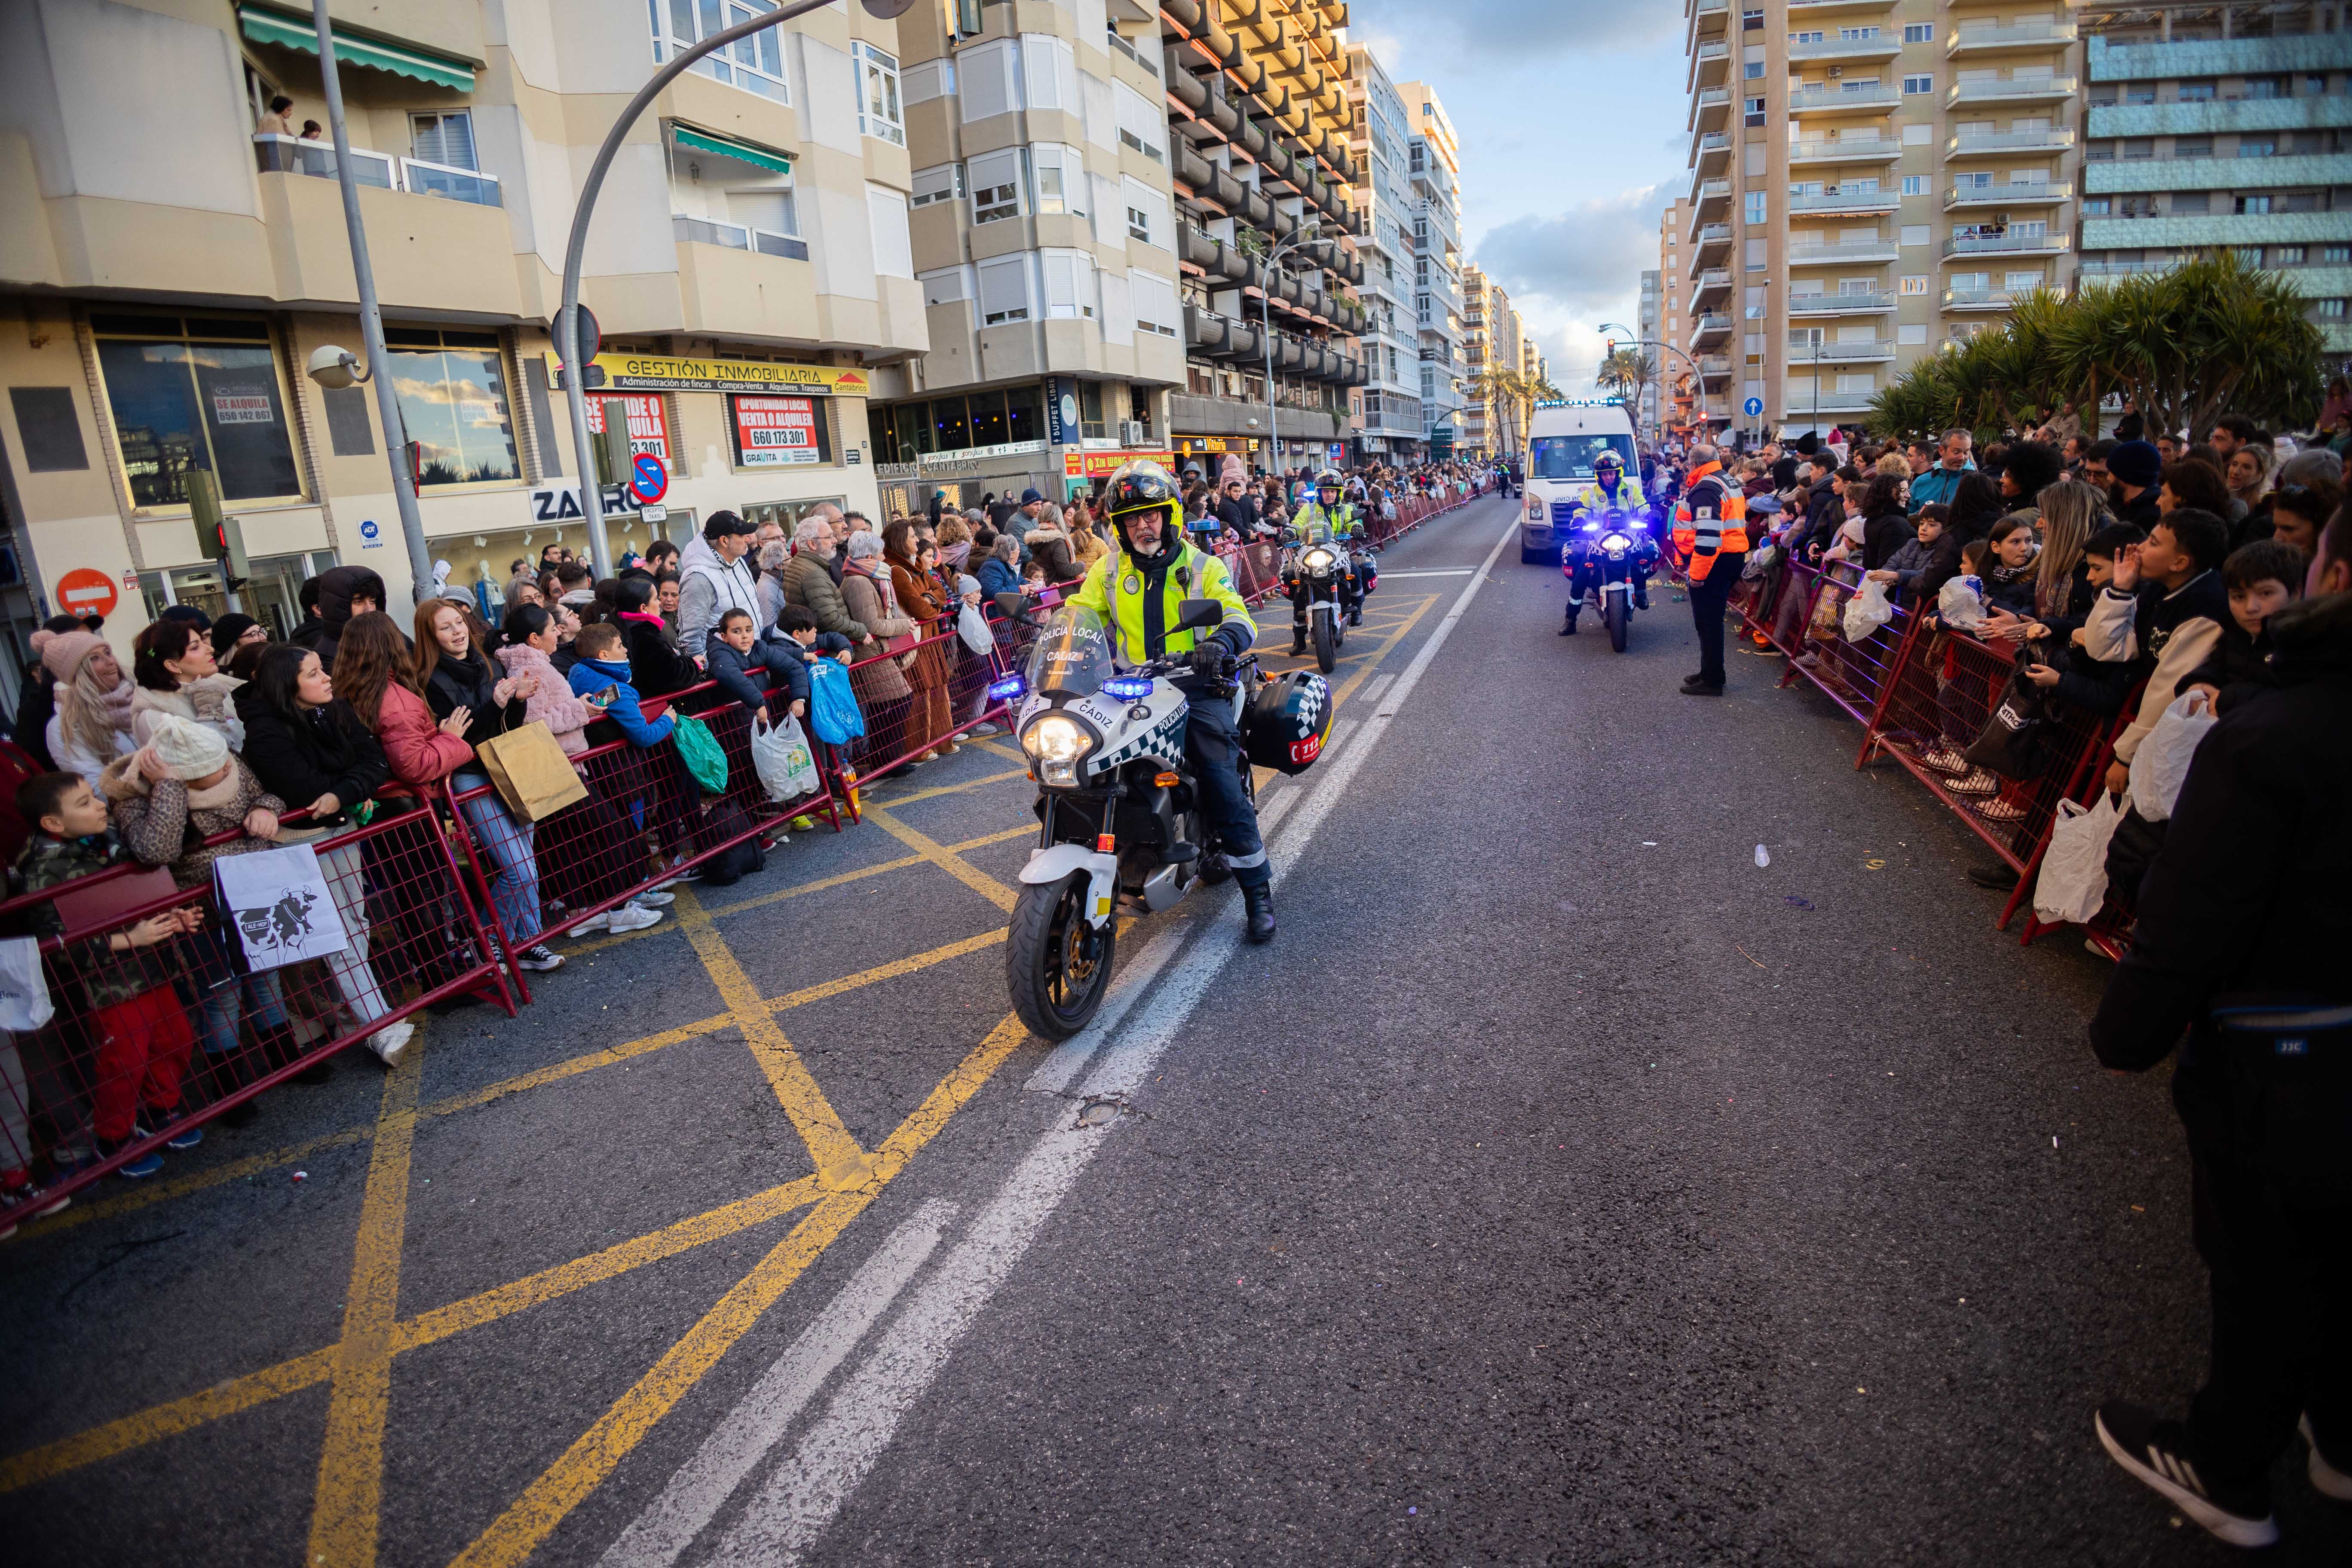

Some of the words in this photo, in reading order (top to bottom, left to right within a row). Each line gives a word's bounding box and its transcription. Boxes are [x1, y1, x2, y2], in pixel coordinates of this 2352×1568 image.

[627, 360, 707, 377] GESTIÓN
[714, 365, 821, 383] INMOBILIARIA
[622, 377, 680, 387] Administración
[680, 380, 690, 388] de
[691, 380, 712, 388] fincas
[717, 380, 764, 391] Compra-Venta
[769, 383, 798, 392] Alquileres
[802, 384, 828, 393] Traspasos
[835, 383, 867, 392] Cantábrico
[1048, 378, 1057, 401] LIBRE
[216, 399, 229, 409] SE
[230, 398, 269, 409] ALQUILA
[740, 398, 789, 411] OPORTUNIDAD
[789, 400, 809, 411] LOCAL
[219, 412, 237, 421] 650
[239, 411, 254, 420] 142
[255, 411, 271, 420] 867
[739, 412, 768, 426] VENTA
[768, 413, 775, 426] O
[775, 413, 813, 428] ALQUILER
[1051, 406, 1060, 436] BUFFET
[753, 431, 772, 444] 660
[773, 431, 788, 444] 173
[789, 431, 805, 444] 301
[1206, 438, 1226, 451] Victoria
[746, 453, 777, 462] GRAVITA
[1095, 457, 1106, 469] XIN
[1107, 456, 1127, 468] WANG
[1161, 454, 1174, 462] BAZAR
[877, 462, 919, 474] EDIFICIO
[1039, 625, 1069, 645] POLICÍA
[1072, 626, 1103, 644] LOCAL
[1079, 704, 1113, 729] CÁDIZ
[1302, 737, 1319, 754] 112
[248, 921, 267, 929] ALE-HOP
